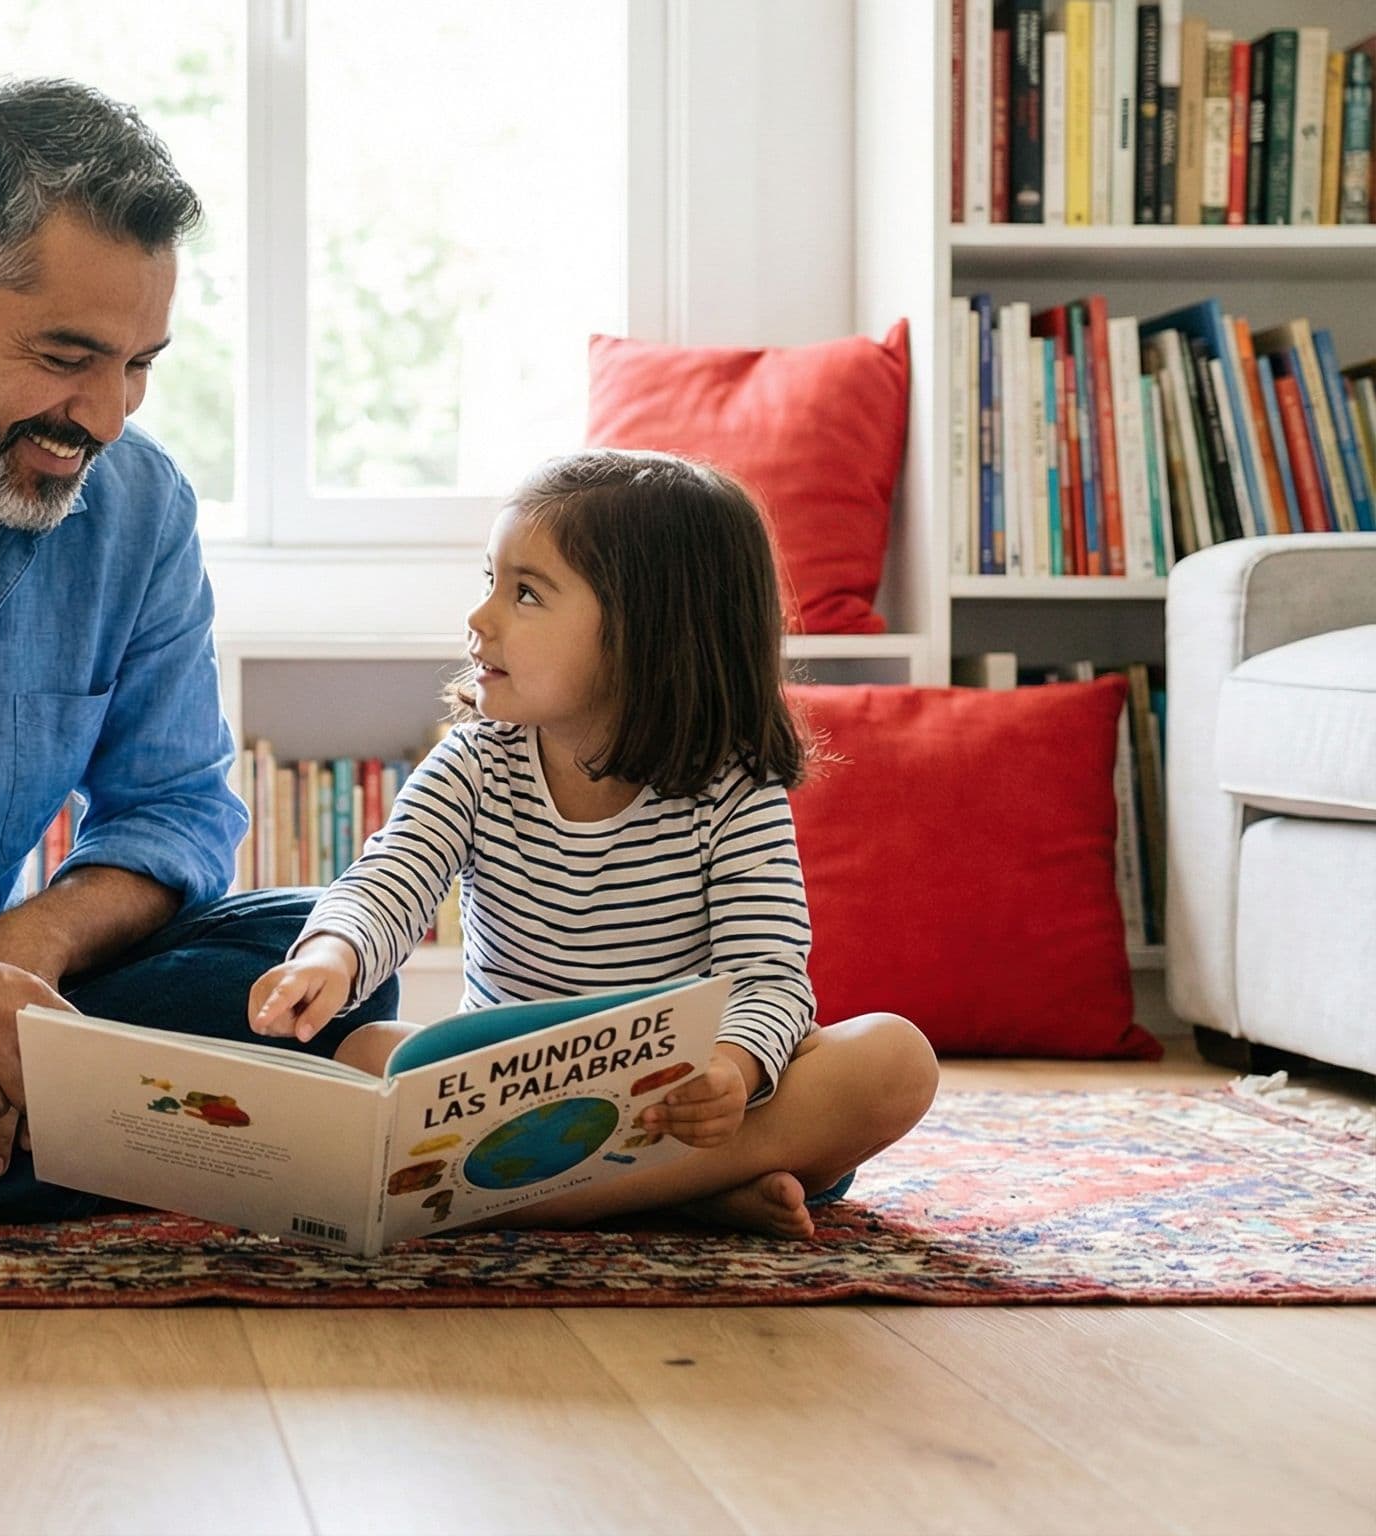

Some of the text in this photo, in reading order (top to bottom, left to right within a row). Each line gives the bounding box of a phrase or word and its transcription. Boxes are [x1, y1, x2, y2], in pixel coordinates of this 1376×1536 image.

[424, 1093, 486, 1129] LAS
[499, 1034, 676, 1106] PALABRAS
[438, 1007, 674, 1099] EL MUNDO DE
